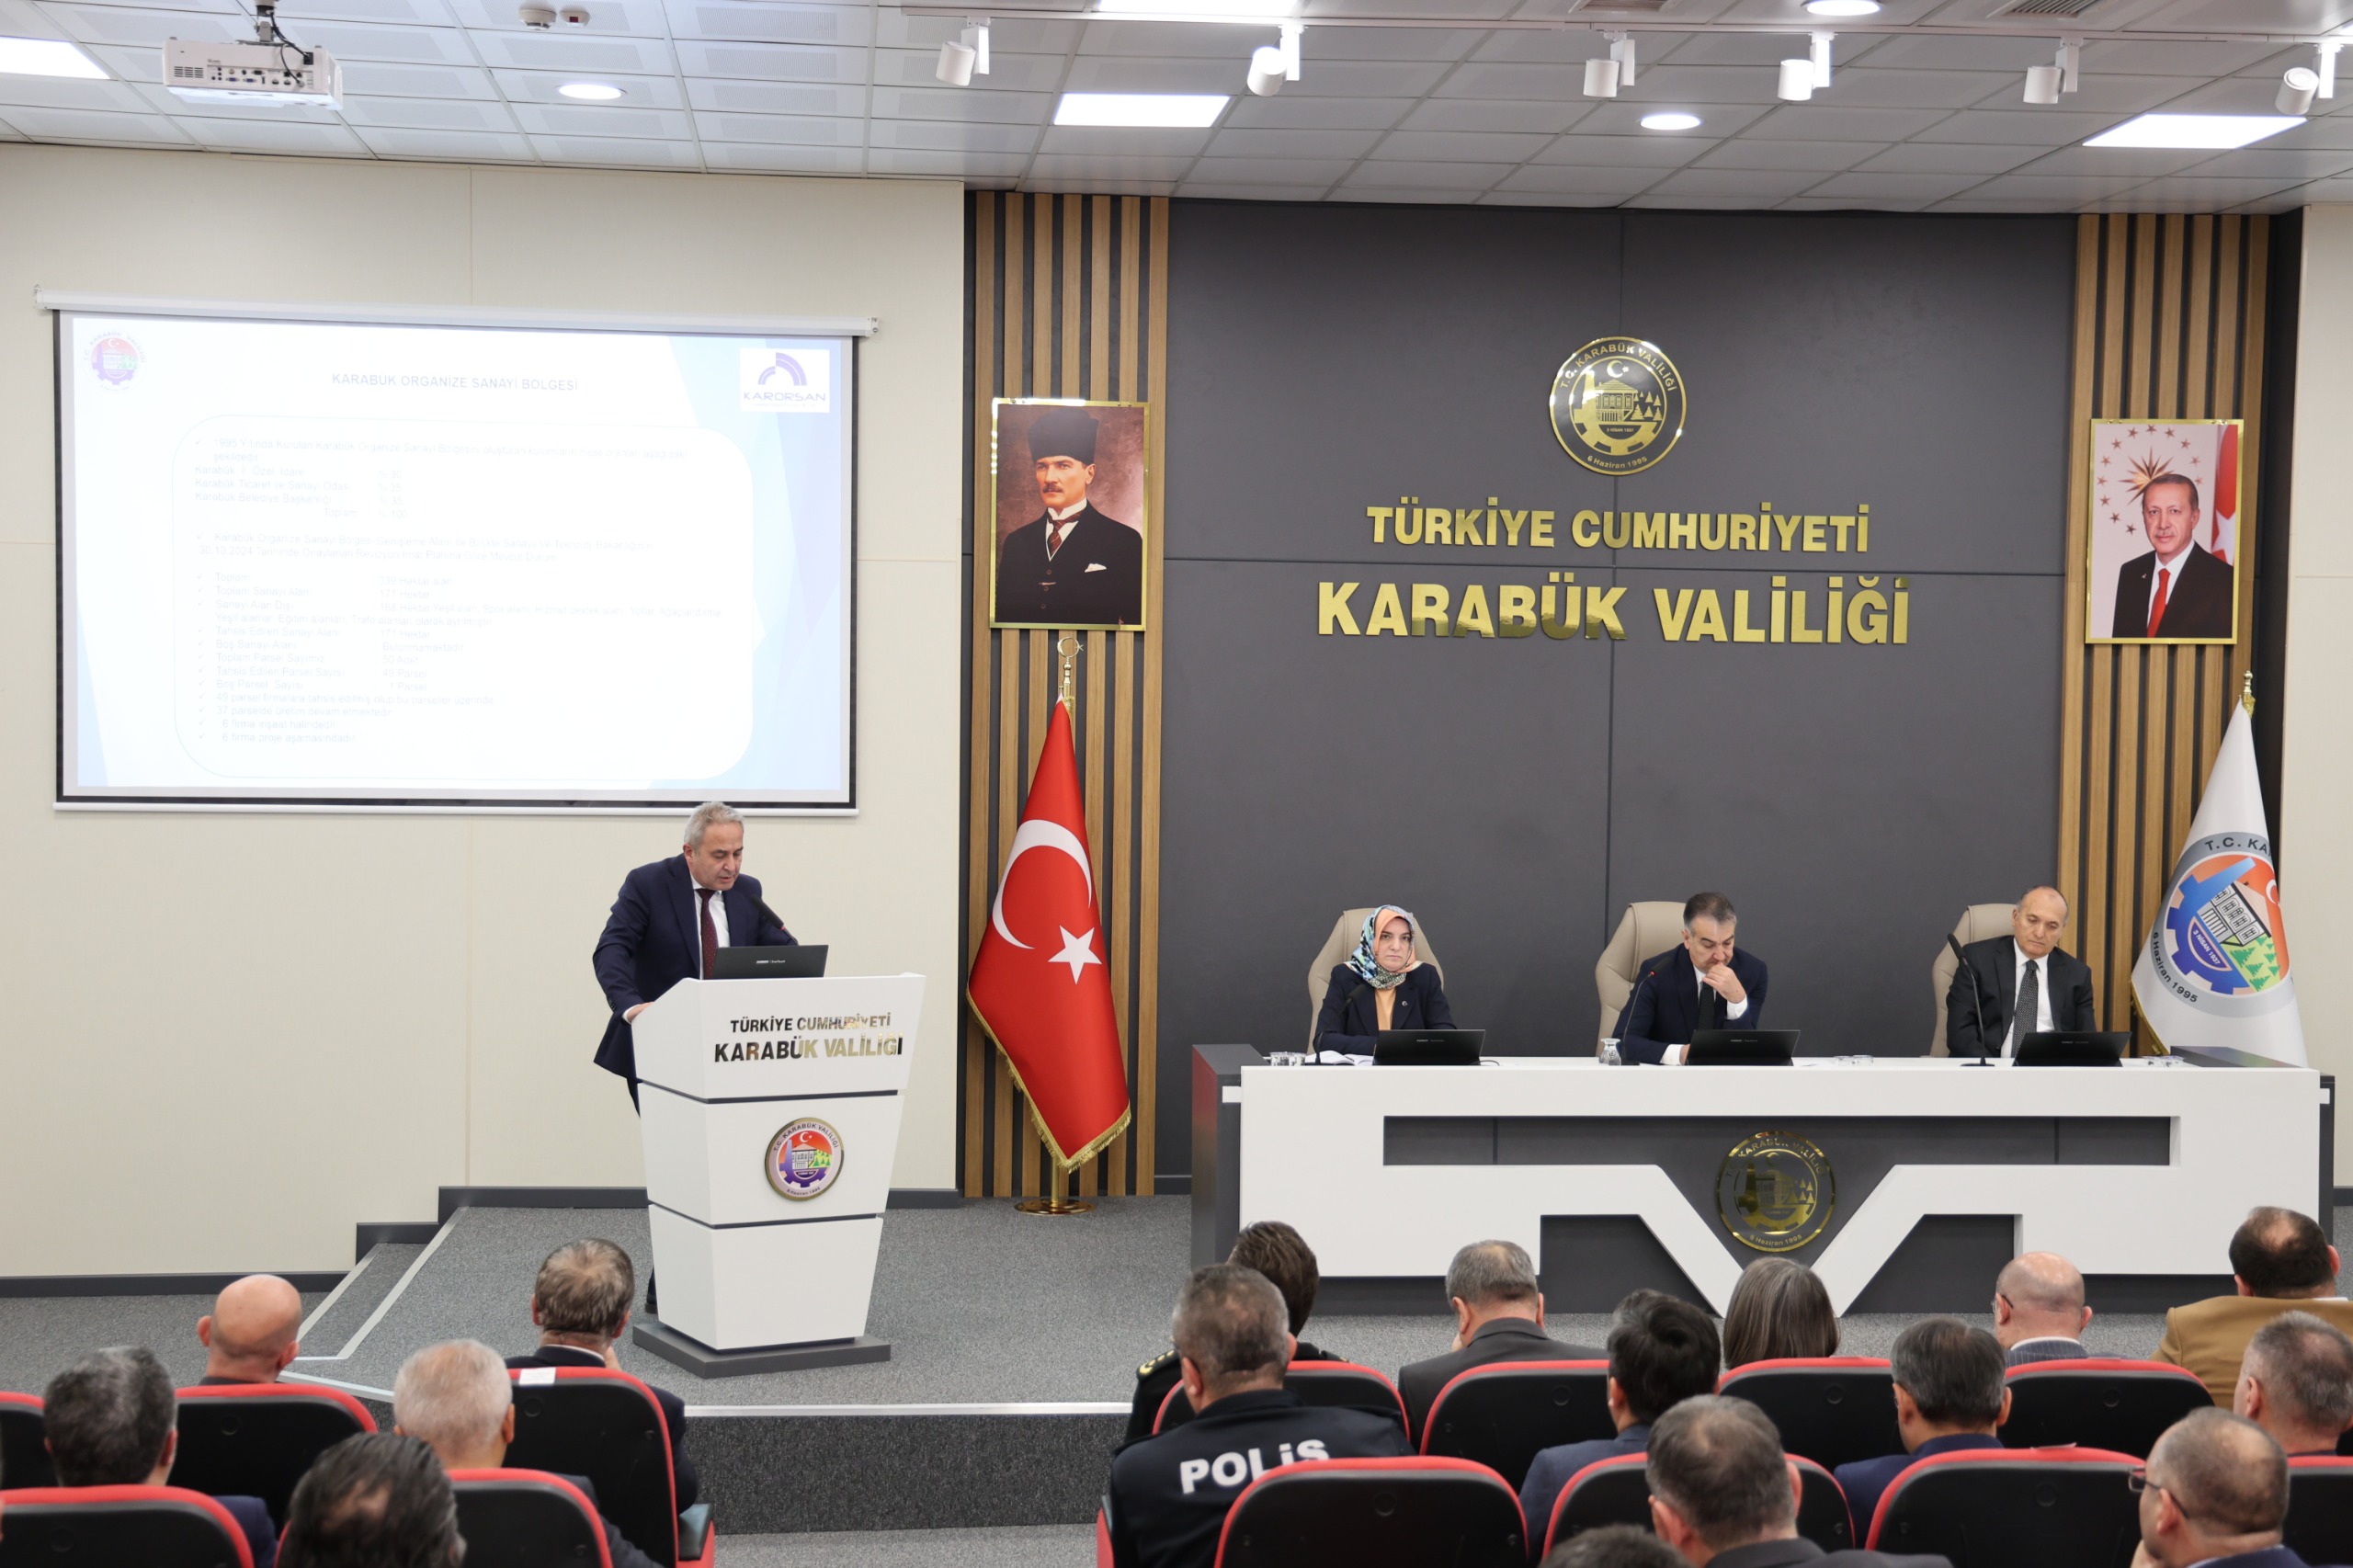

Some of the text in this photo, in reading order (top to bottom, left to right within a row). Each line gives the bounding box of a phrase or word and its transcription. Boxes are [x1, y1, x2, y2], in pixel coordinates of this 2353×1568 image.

[1560, 342, 1678, 392] T.C. KARABÜK VALİLİĞİ
[401, 374, 467, 387] ORGANİZE
[471, 375, 517, 389] SANAYİ
[744, 392, 825, 402] KARORSAN
[1594, 458, 1625, 470] Haziran
[1627, 456, 1648, 469] 1995
[1367, 496, 1870, 551] TÜRKİYE CUMHURİYETİ
[1318, 572, 1911, 645] KARABÜK VALİLİĞİ
[2204, 837, 2241, 851] T.C.
[2197, 933, 2211, 954] NİSAN
[2208, 950, 2222, 965] 1937
[2153, 940, 2172, 983] Haziran
[2171, 981, 2199, 1004] 1995
[730, 1012, 892, 1033] TÜRKİYE CUMHURİYETİ
[715, 1031, 904, 1062] KARABÜK VALİLİĞİ
[783, 1123, 816, 1140] KARABÜK
[818, 1123, 840, 1149] VALİLİĞİ
